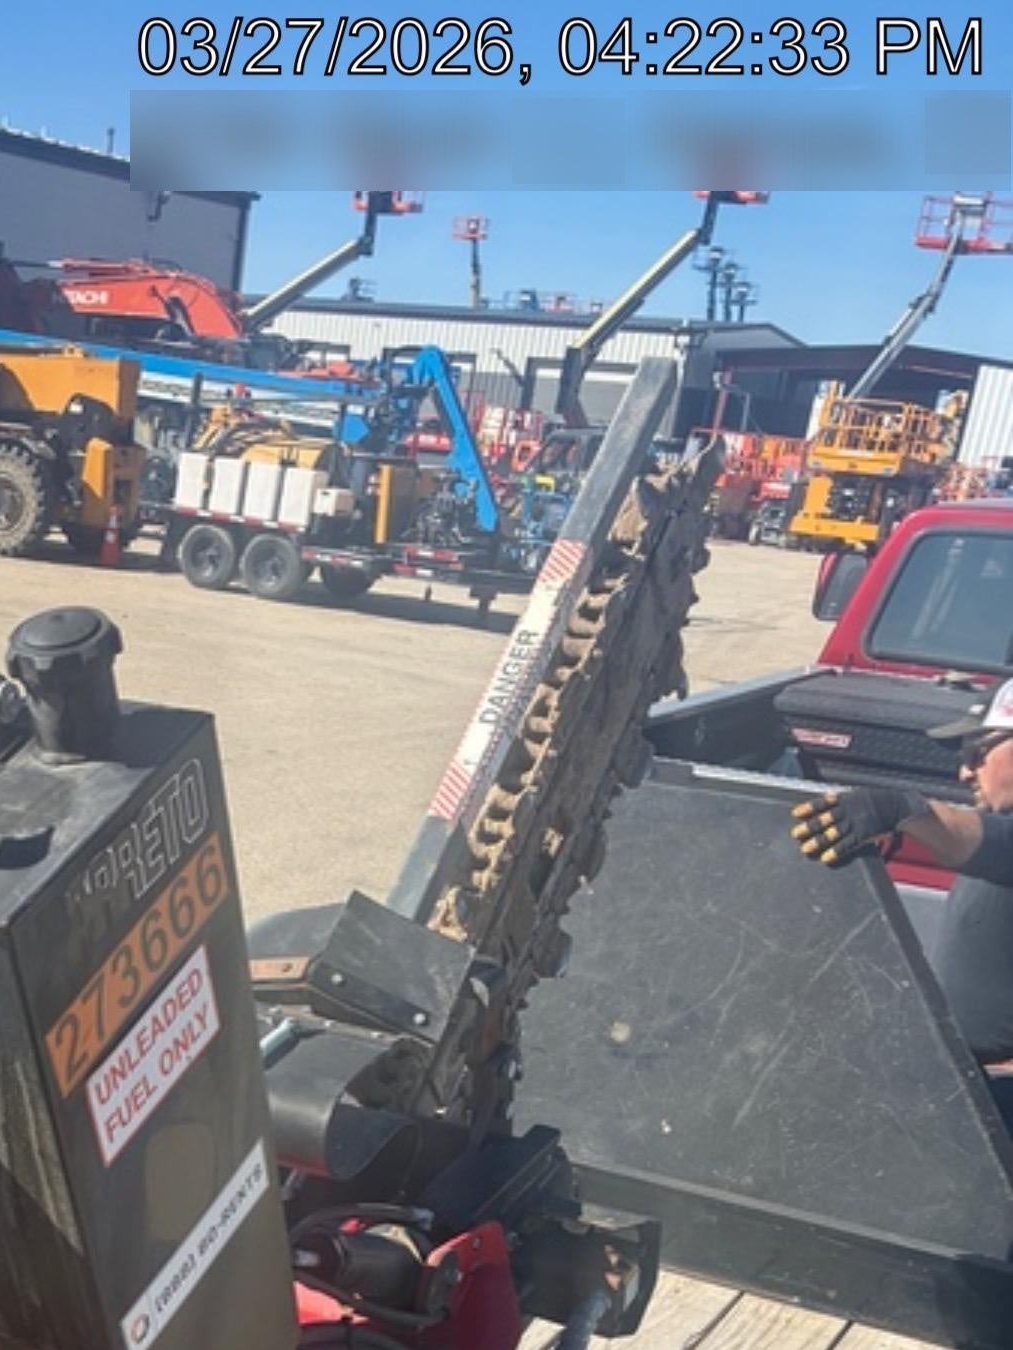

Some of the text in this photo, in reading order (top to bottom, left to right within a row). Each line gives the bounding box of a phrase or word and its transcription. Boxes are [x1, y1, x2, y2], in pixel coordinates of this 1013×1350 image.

[478, 629, 541, 724] DANGER
[56, 846, 222, 1083] 273666
[95, 967, 203, 1106] UNLEADED
[104, 1003, 209, 1144] FUEL ONLY
